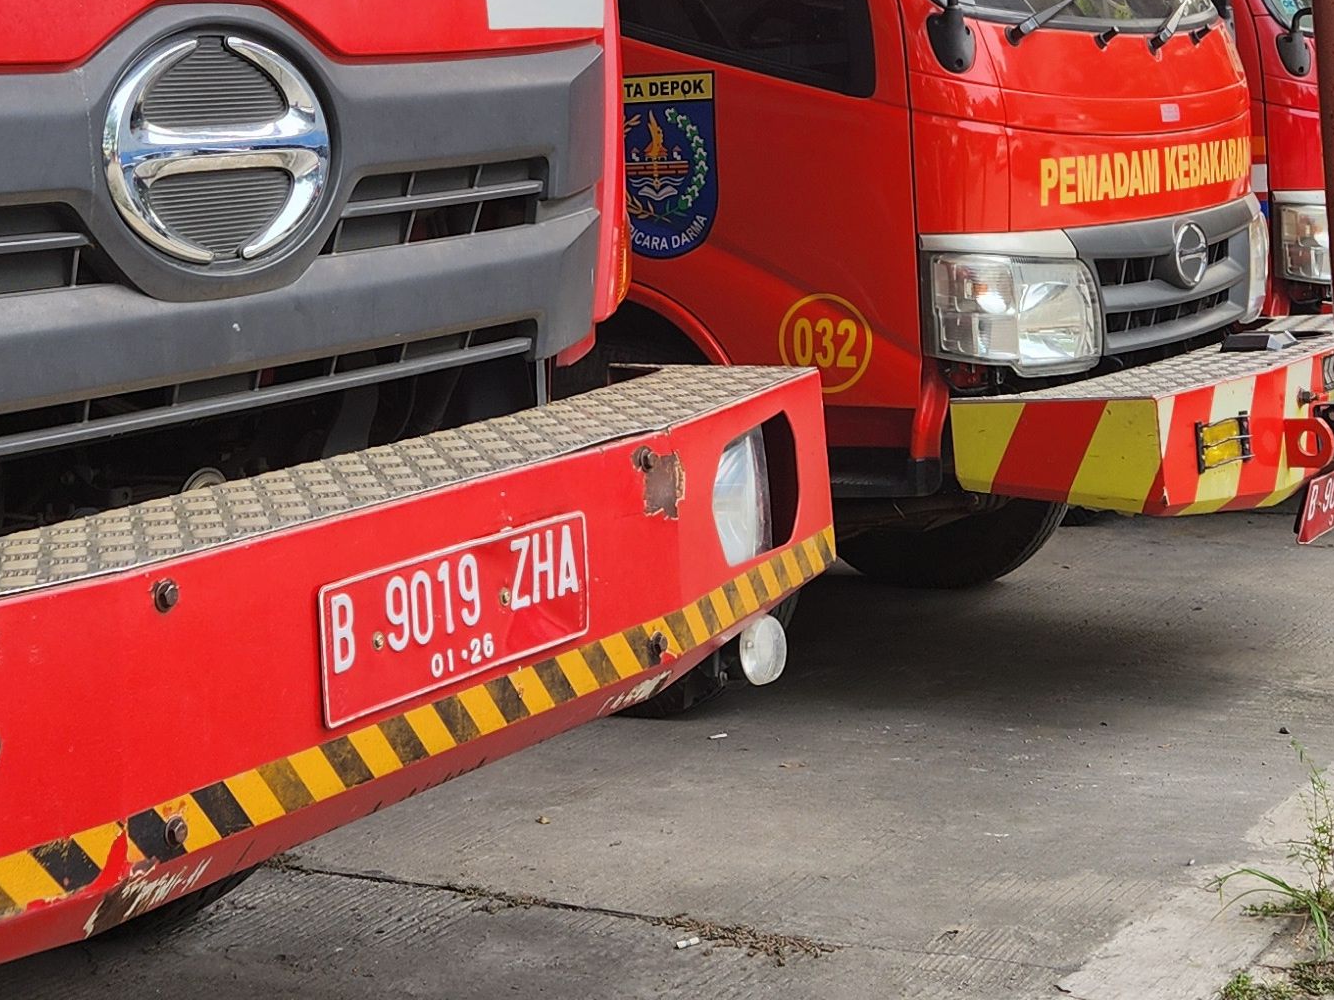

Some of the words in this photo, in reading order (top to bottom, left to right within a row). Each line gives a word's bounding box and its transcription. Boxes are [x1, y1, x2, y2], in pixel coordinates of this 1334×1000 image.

[648, 79, 704, 97] DEPOK
[1040, 149, 1160, 207] PEMADAM
[671, 214, 707, 249] DARMA
[793, 317, 858, 368] 032
[1307, 484, 1319, 521] B
[331, 592, 356, 674] B
[385, 553, 481, 652] 9019
[510, 524, 580, 611] ZHA
